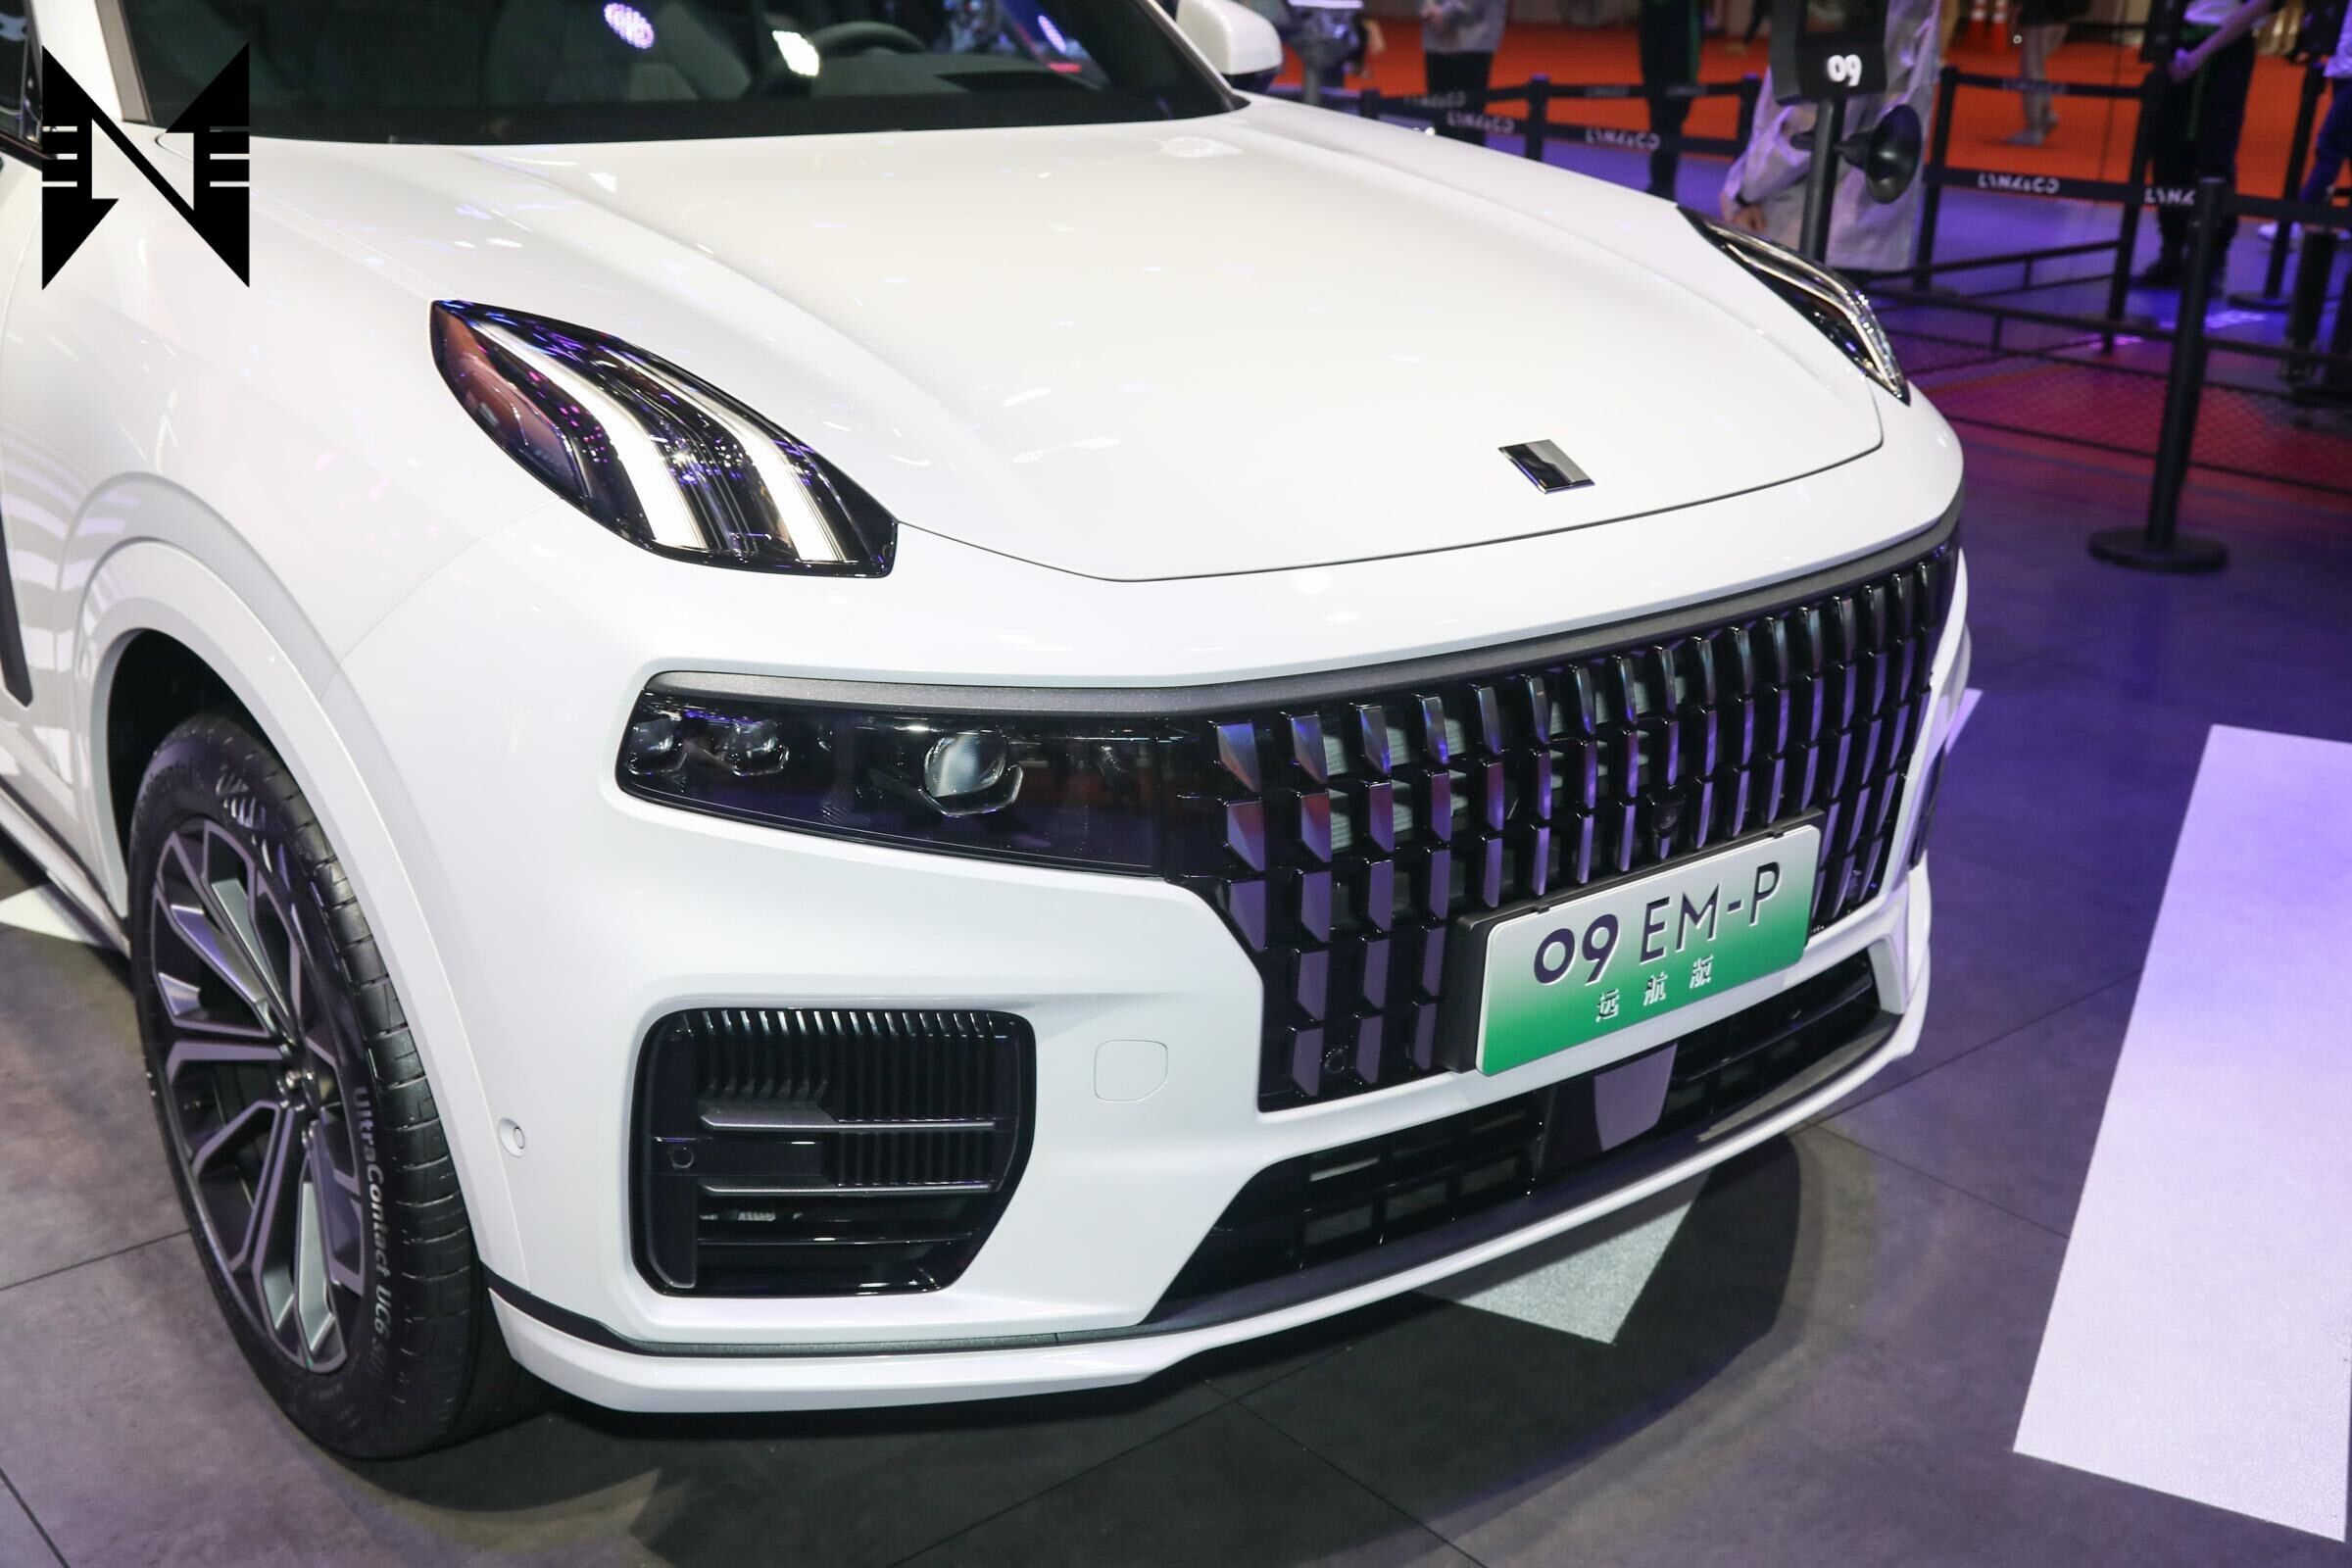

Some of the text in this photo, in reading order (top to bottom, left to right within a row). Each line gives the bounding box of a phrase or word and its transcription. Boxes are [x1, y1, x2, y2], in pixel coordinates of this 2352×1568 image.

[1827, 54, 1862, 86] 09
[2143, 186, 2197, 207] LYNK
[1533, 860, 1782, 987] 09 EM-P
[353, 1086, 390, 1277] UltraContact
